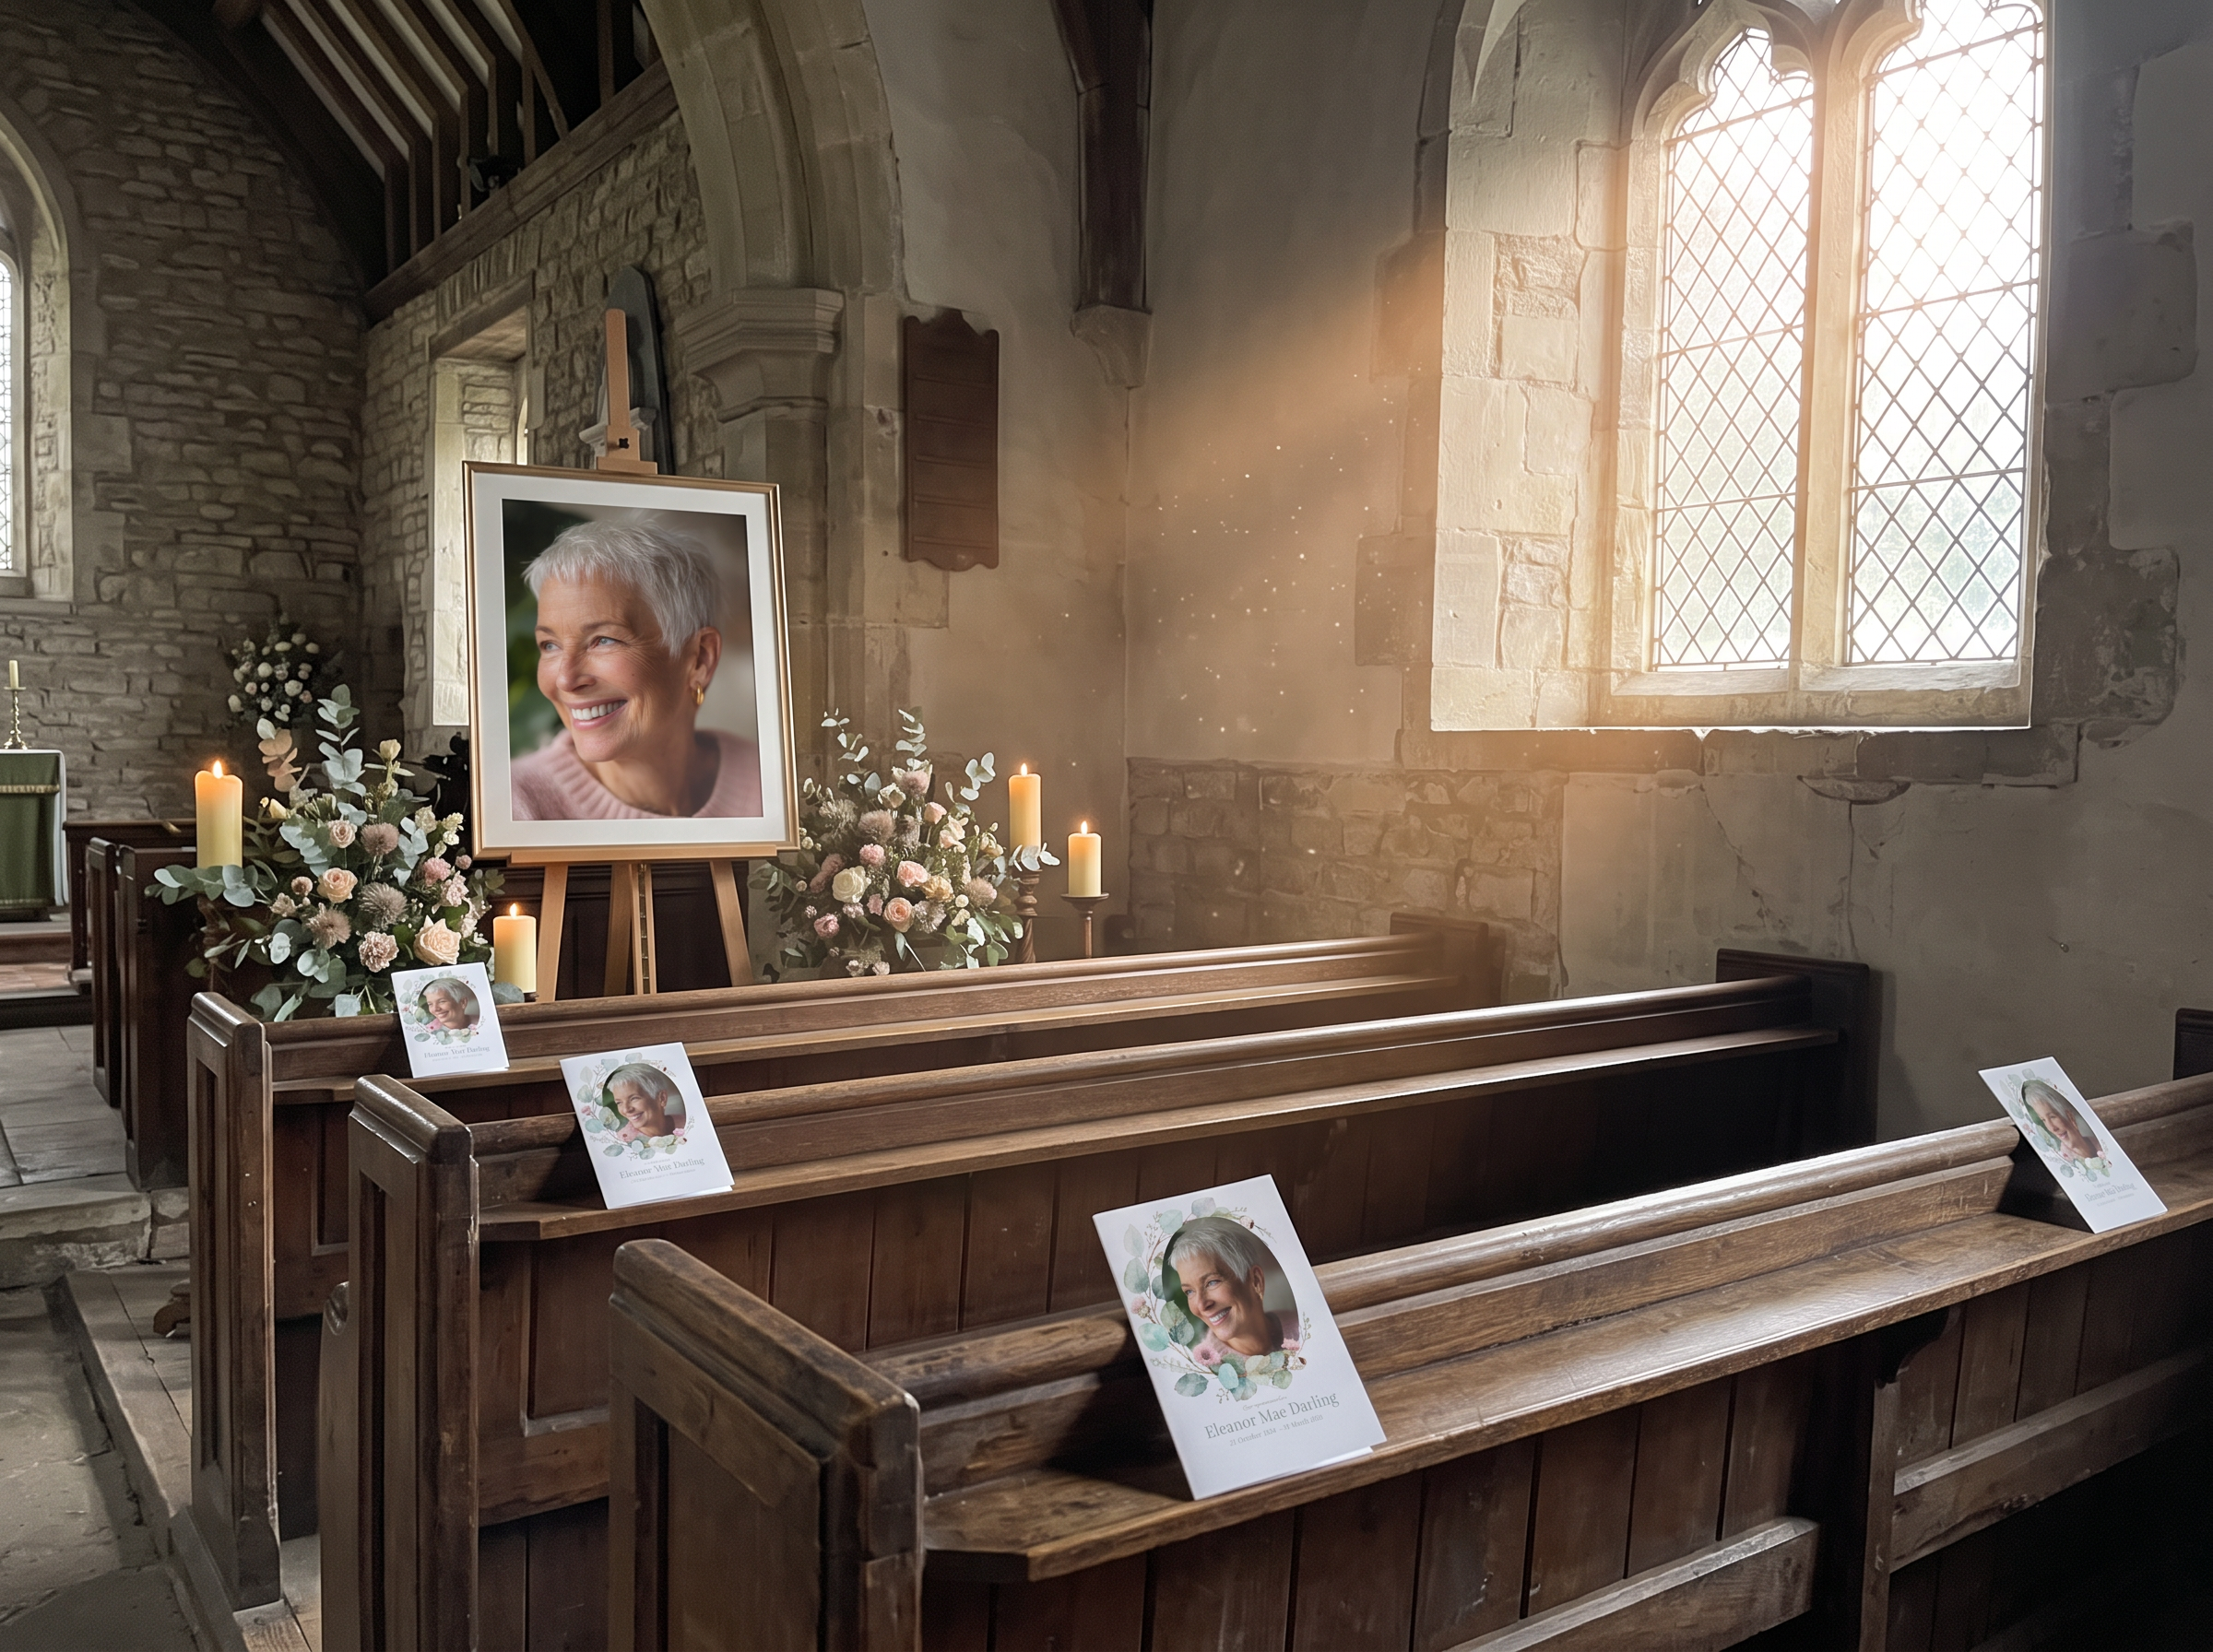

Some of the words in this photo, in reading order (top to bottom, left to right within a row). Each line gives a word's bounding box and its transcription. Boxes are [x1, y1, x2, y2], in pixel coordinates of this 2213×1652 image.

[1204, 1416, 1257, 1439] Eleanor
[1258, 1409, 1287, 1424] Mae
[1288, 1393, 1340, 1416] Darling
